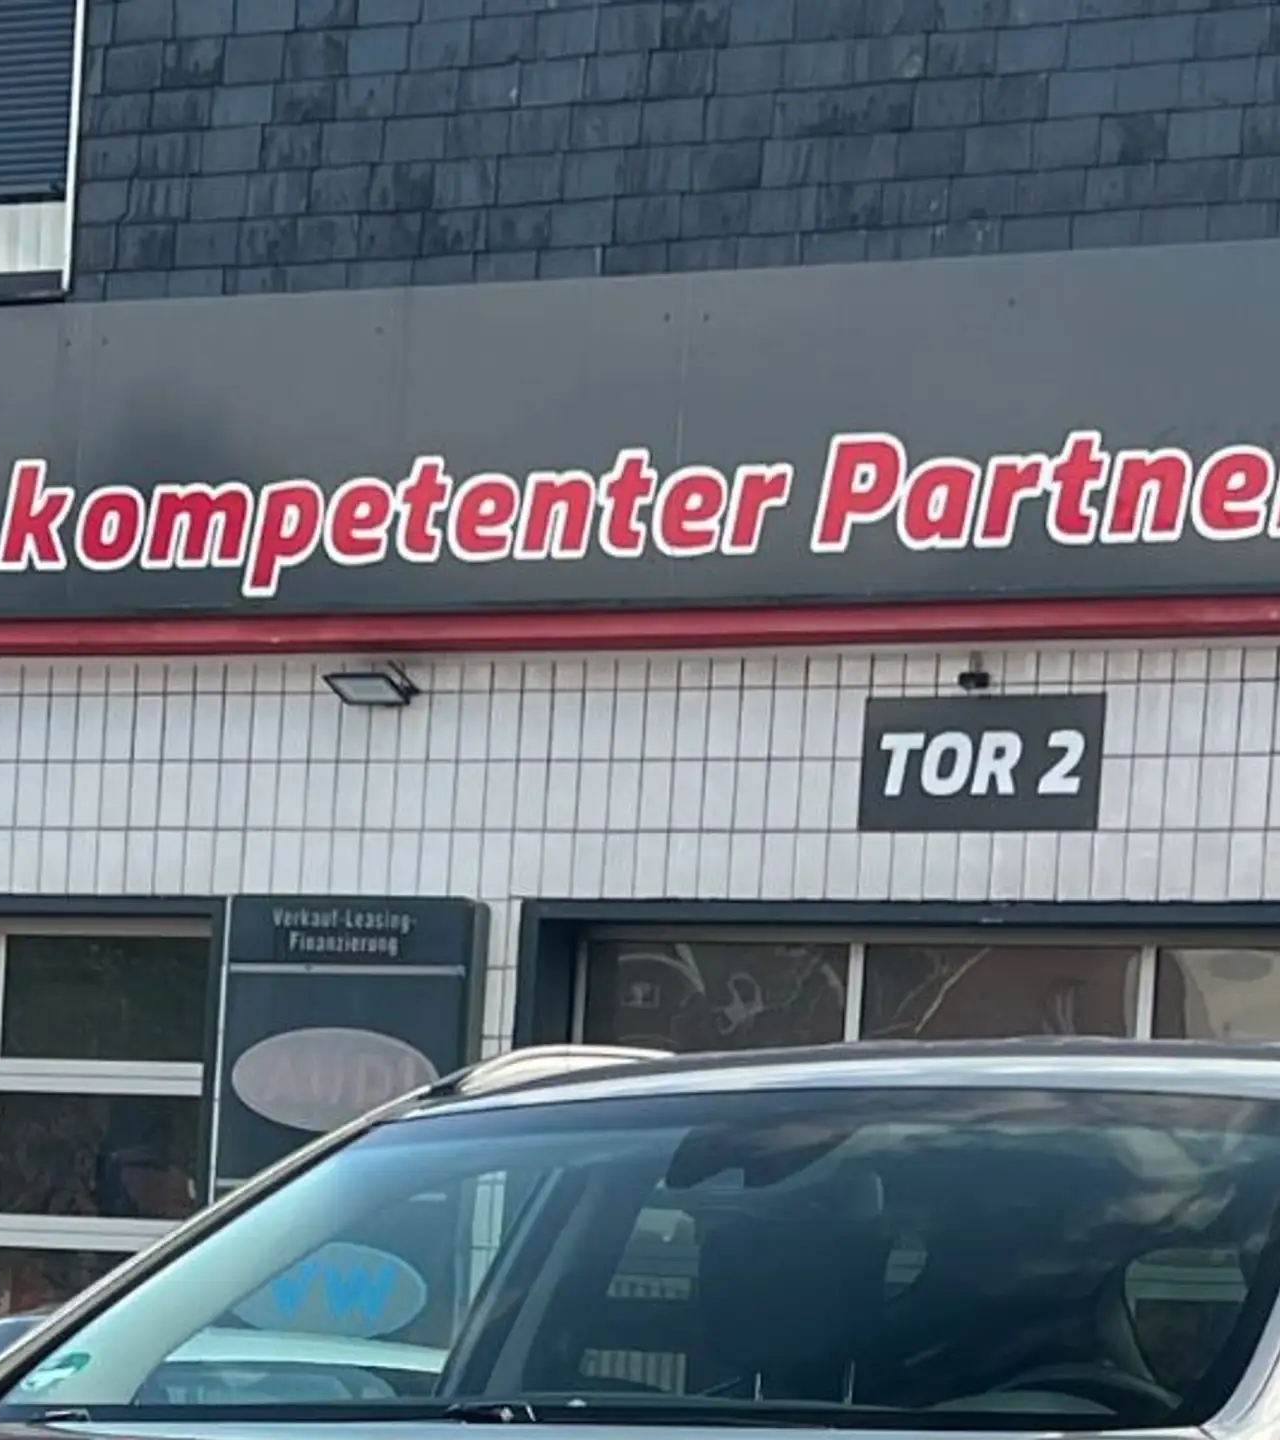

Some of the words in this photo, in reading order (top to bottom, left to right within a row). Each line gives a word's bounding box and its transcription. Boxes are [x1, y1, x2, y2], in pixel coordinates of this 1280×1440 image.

[879, 730, 1023, 797] TOR
[1037, 729, 1086, 795] 2
[288, 931, 399, 957] Finanzierung
[272, 1259, 398, 1321] VW
